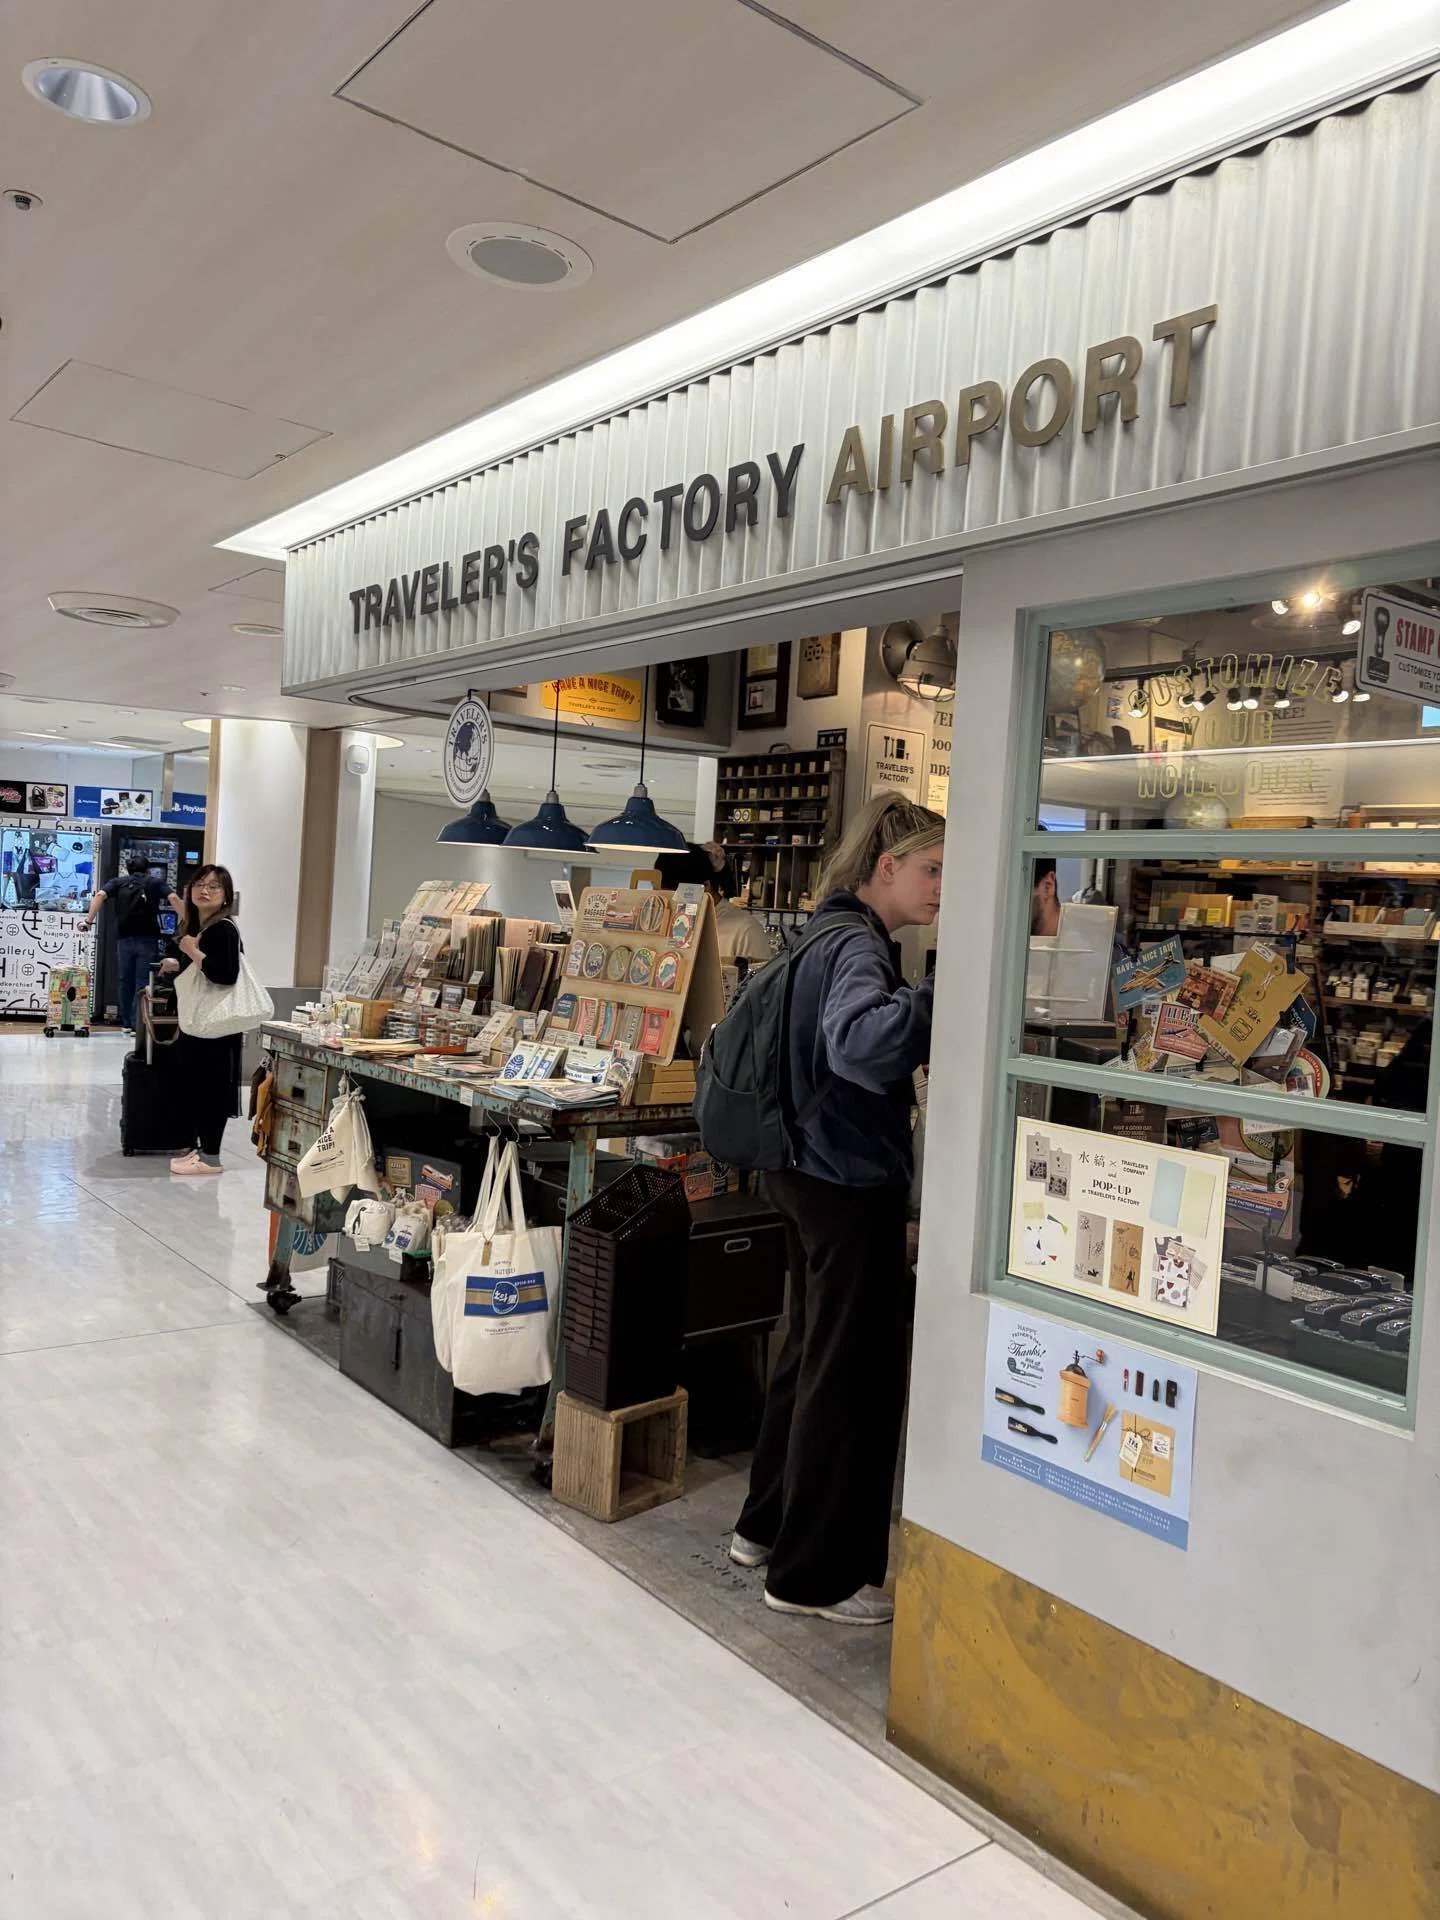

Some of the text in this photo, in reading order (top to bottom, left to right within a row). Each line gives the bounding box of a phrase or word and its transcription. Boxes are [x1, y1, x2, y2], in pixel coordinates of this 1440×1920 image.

[349, 303, 1219, 635] TRAVELER'S FACTORY AIRPORT
[1395, 618, 1435, 656] STAMP
[588, 677, 609, 693] NICE
[876, 762, 914, 775] TRAVELER'S
[879, 773, 910, 784] FACTORY
[316, 1141, 335, 1153] TRIP!
[1121, 1159, 1149, 1171] TRAVELER'S
[1123, 1166, 1146, 1176] COMPANY
[1092, 1179, 1132, 1196] POP-UP
[1088, 1189, 1116, 1201] TRAVELER'S
[1117, 1196, 1140, 1207] FACTORY
